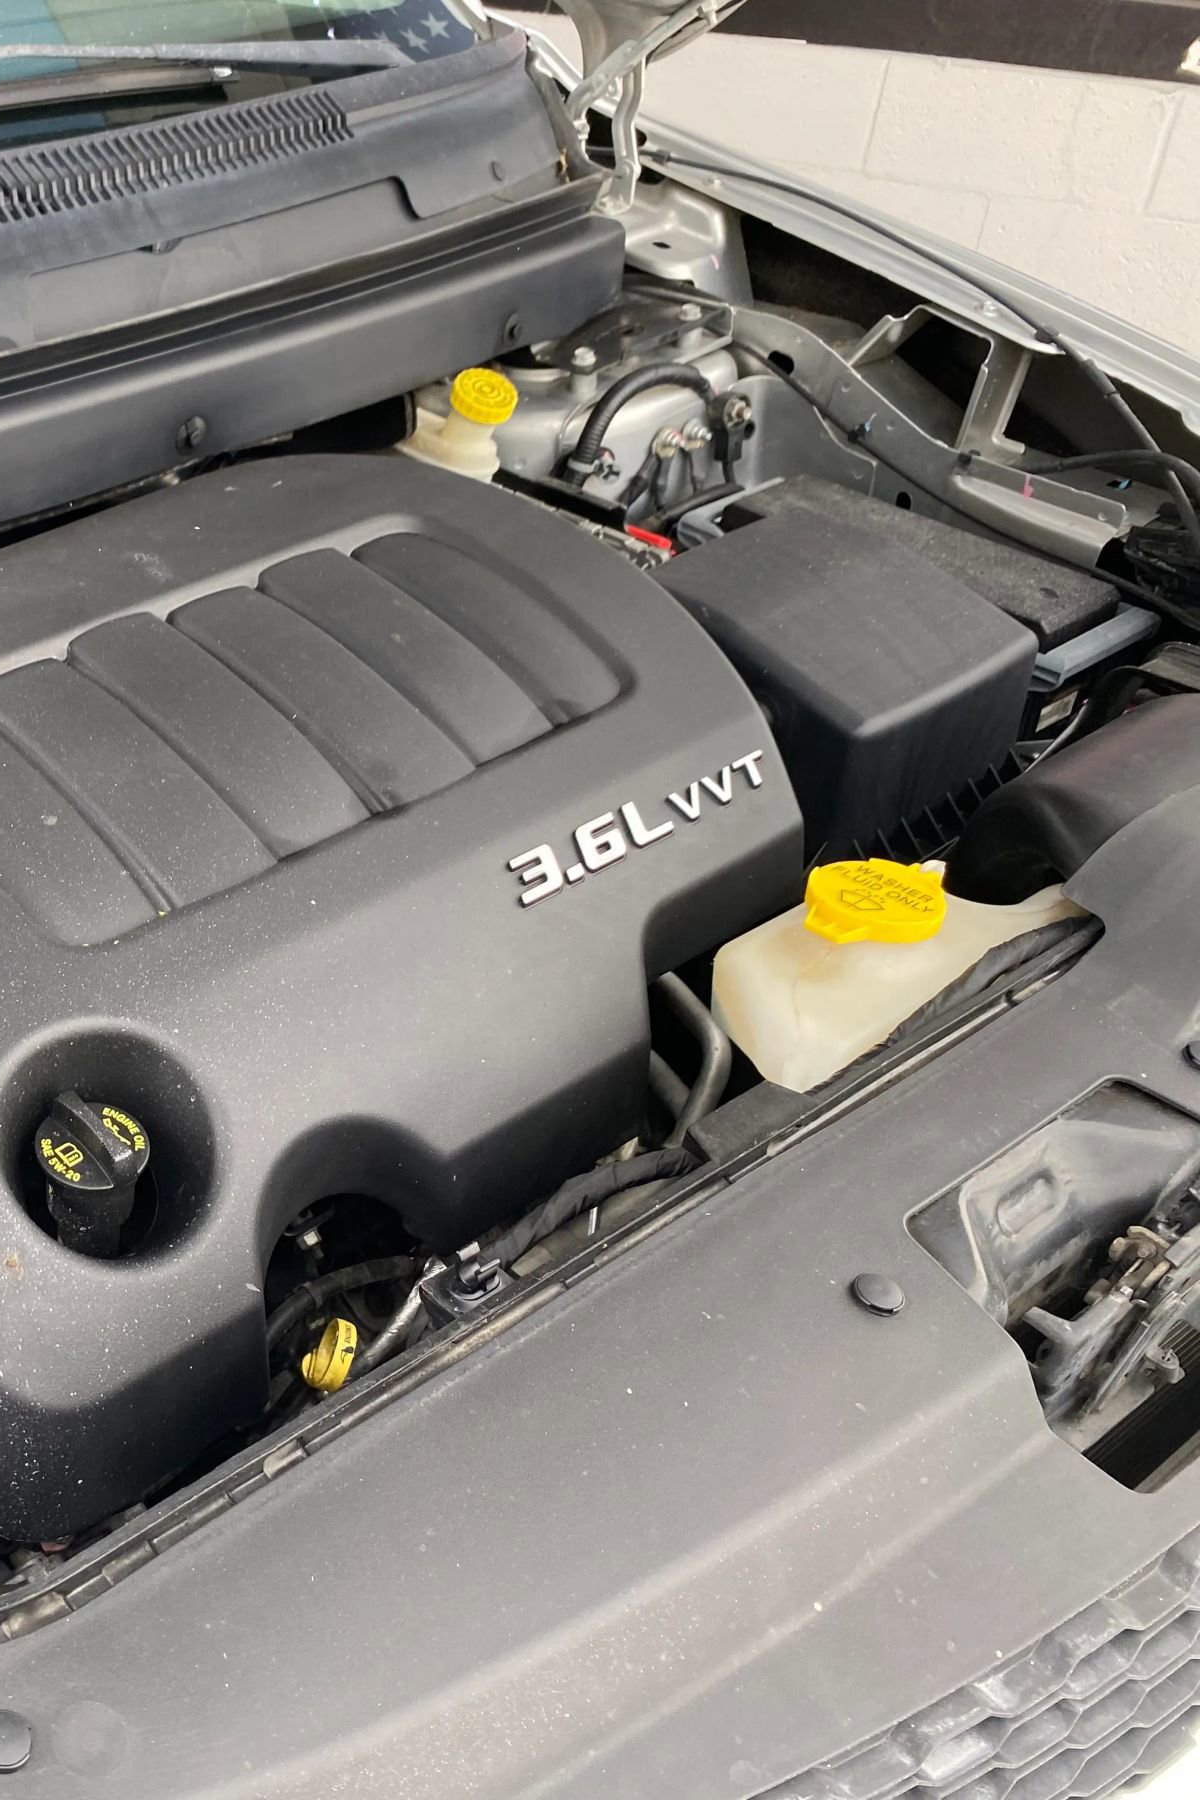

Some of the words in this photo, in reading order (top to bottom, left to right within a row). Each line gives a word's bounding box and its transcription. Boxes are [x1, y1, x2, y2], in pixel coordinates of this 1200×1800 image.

[506, 801, 674, 908] 3.6L
[665, 749, 764, 824] VVT
[831, 865, 884, 891] FLUID
[886, 890, 937, 913] ONLY
[855, 865, 934, 903] WASHER
[102, 1107, 141, 1137] ENGINE
[133, 1134, 147, 1152] OIL
[40, 1137, 55, 1158] SAE
[48, 1157, 81, 1183] 5W-20
